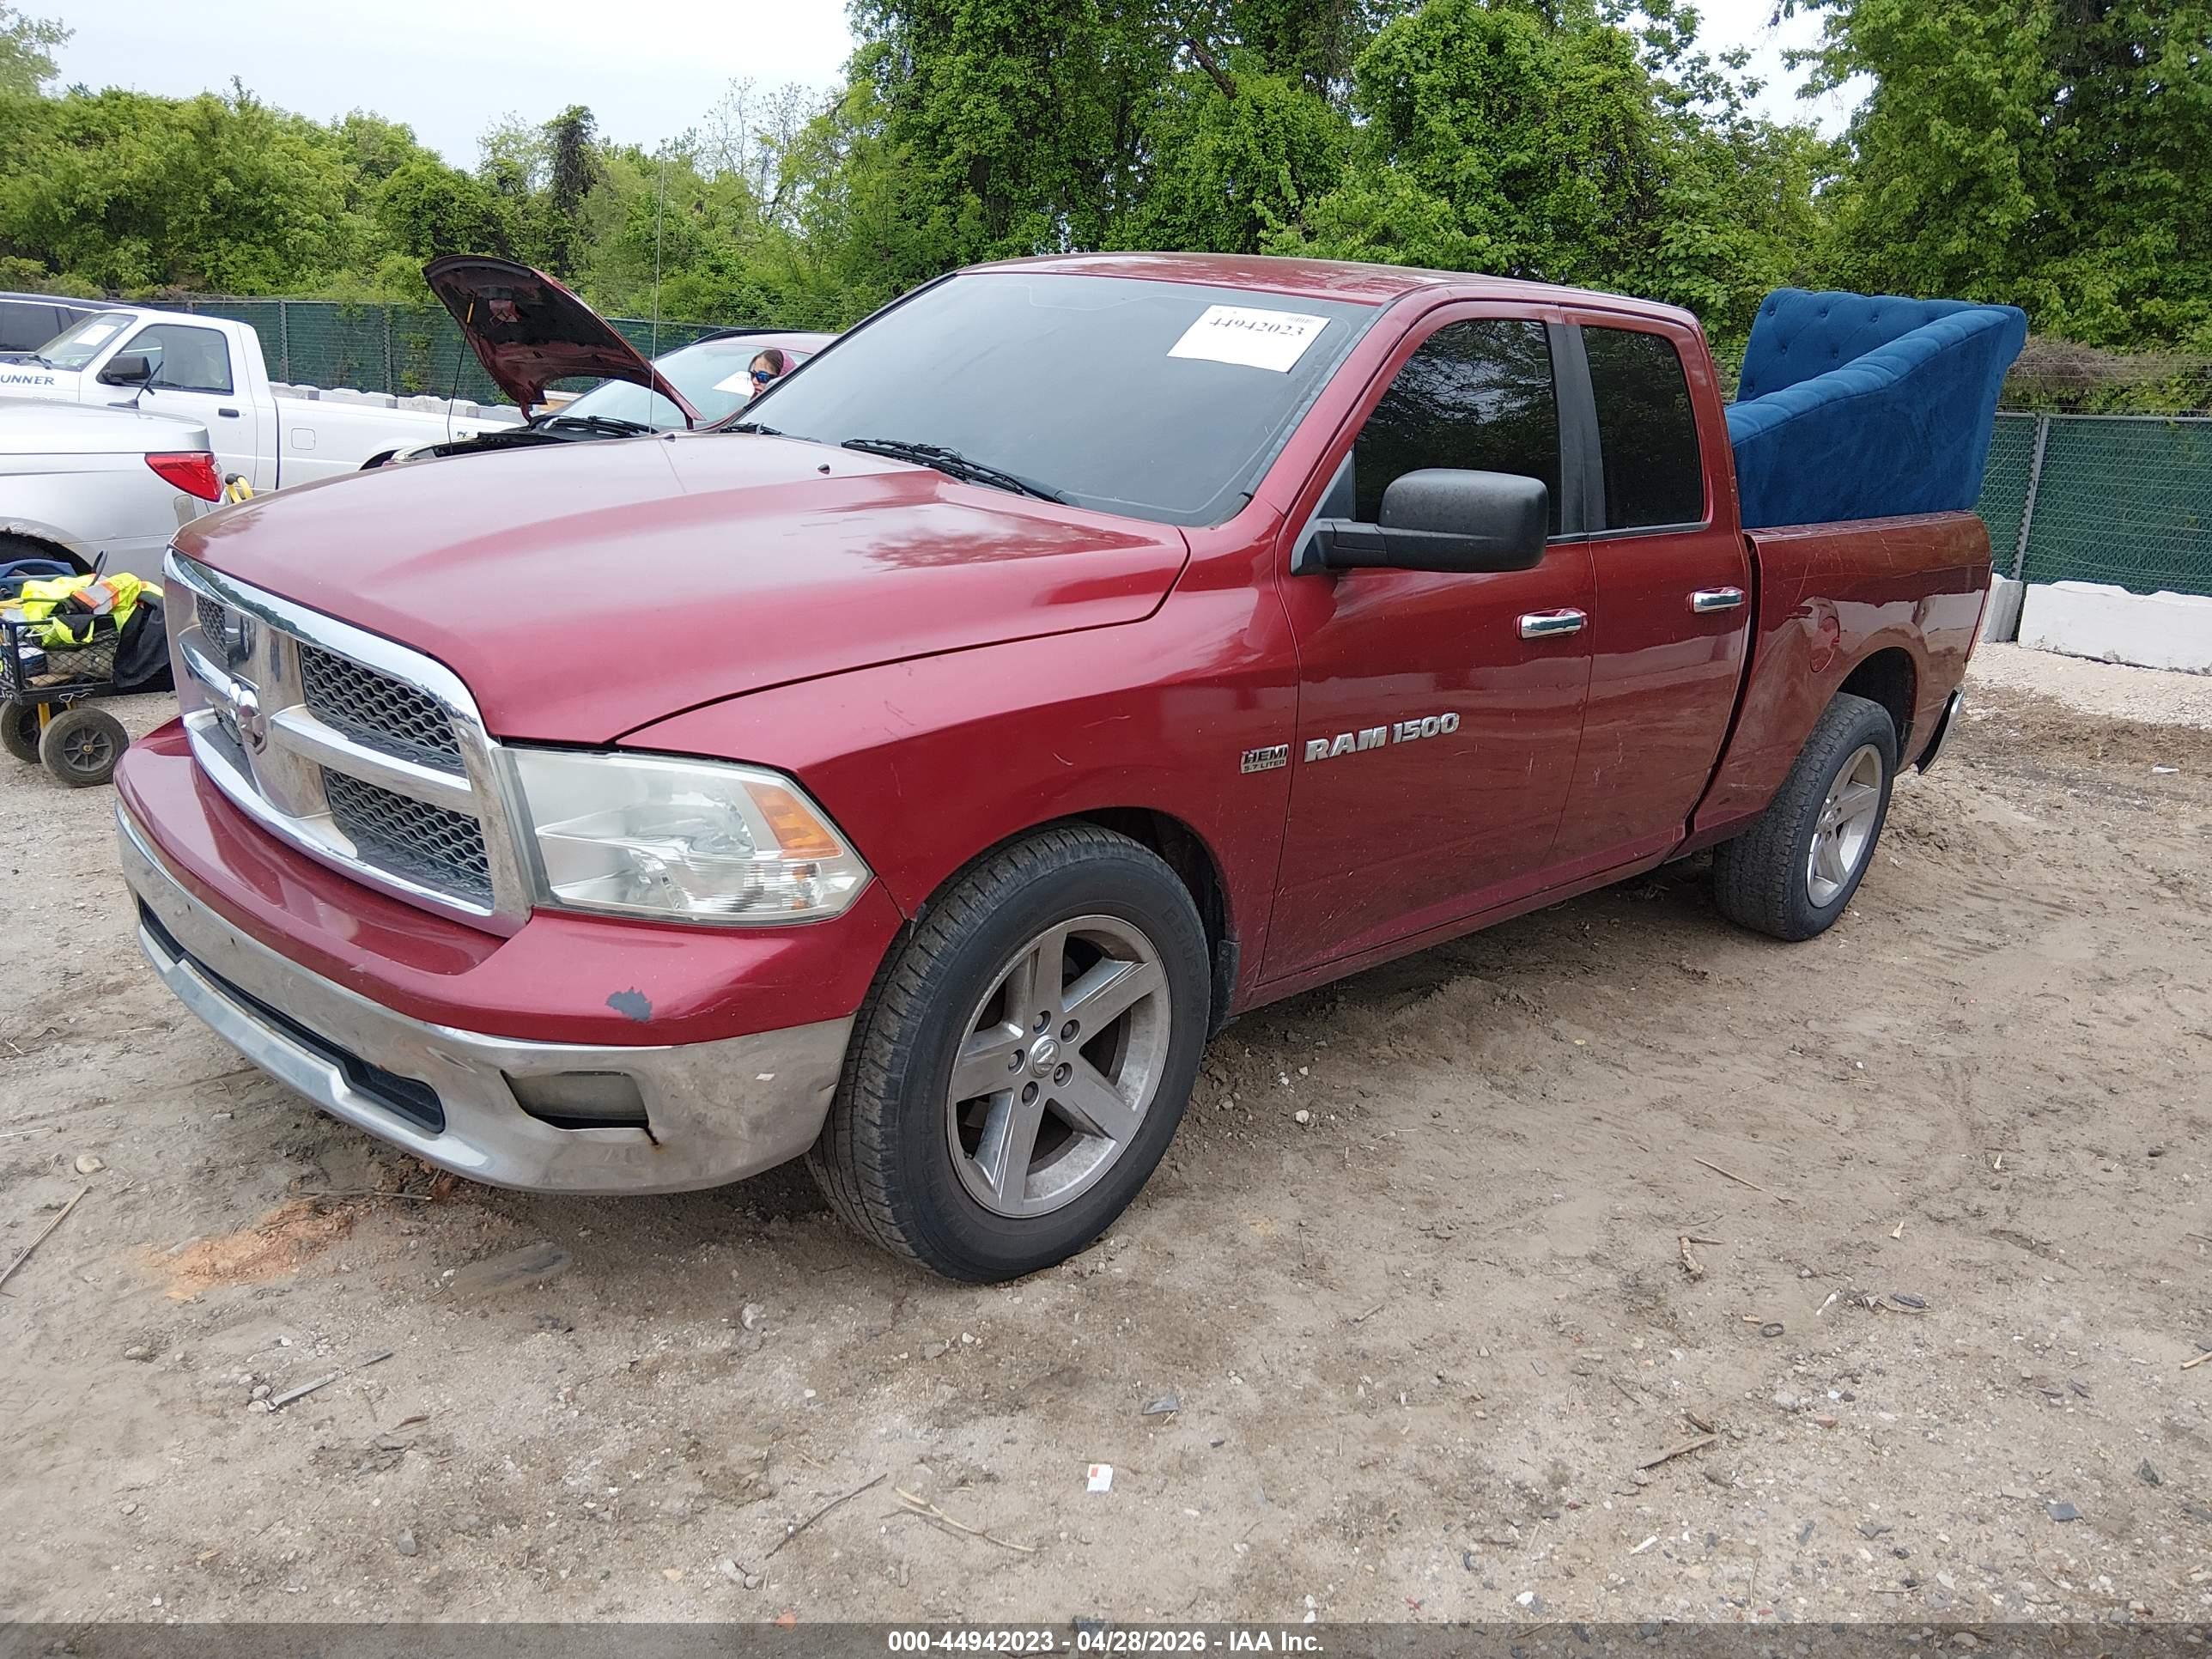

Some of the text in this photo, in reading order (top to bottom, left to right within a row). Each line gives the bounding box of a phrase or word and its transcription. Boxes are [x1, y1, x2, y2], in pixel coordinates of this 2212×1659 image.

[1209, 317, 1305, 337] 44942023
[1304, 712, 1461, 763] RAM 1500
[1243, 746, 1288, 764] HEMI
[1243, 759, 1285, 772] 5.7 LITER
